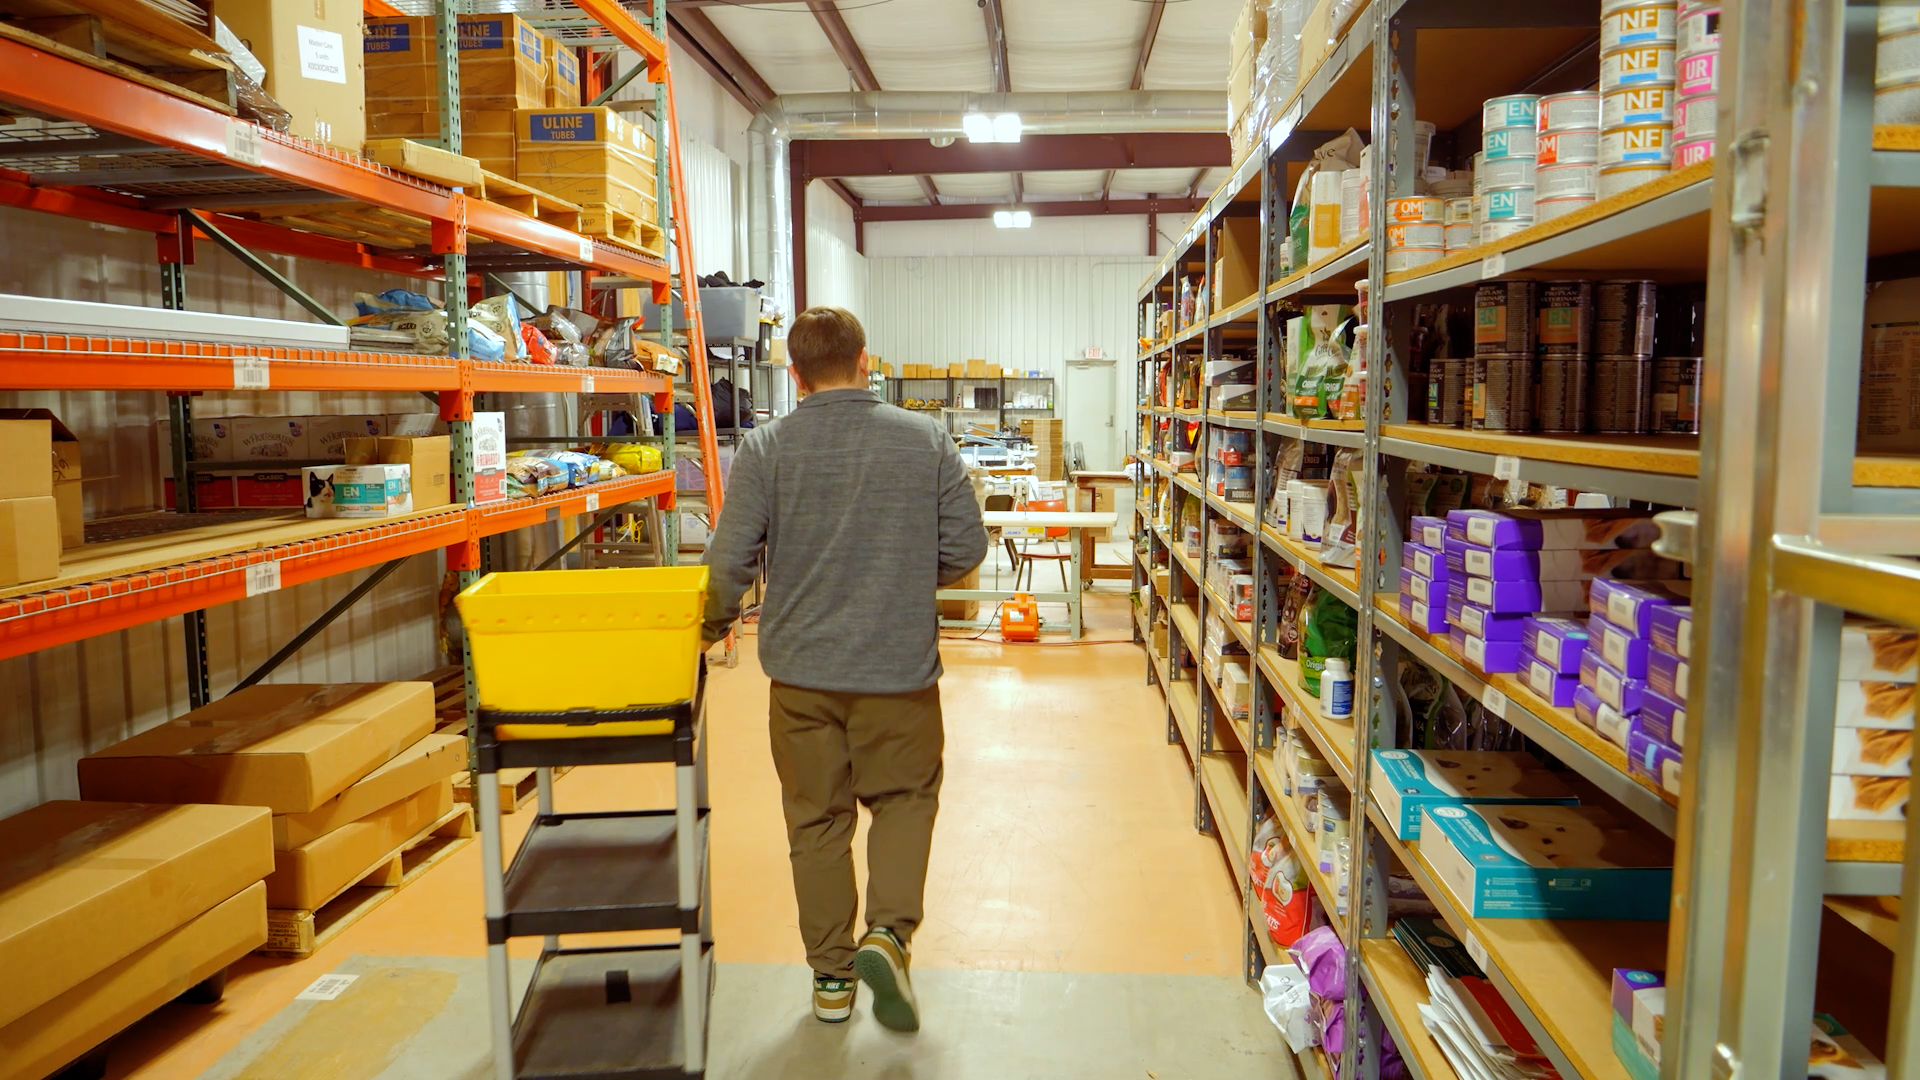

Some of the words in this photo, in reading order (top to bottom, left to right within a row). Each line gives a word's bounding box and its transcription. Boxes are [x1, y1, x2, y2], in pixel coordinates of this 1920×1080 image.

[1621, 8, 1658, 32] NF
[364, 26, 398, 39] LINE
[457, 24, 491, 37] LINE
[308, 38, 323, 48] Master
[323, 40, 334, 50] Case
[365, 42, 391, 50] TUBES
[458, 39, 484, 48] TUBES
[319, 52, 330, 61] units
[1621, 49, 1658, 72] NF
[1685, 58, 1708, 81] UR
[1626, 89, 1663, 111] NF
[1508, 101, 1535, 117] EN
[542, 115, 583, 129] ULINE
[550, 130, 576, 140] TUBES
[1487, 131, 1508, 149] EN
[1625, 128, 1662, 149] NF
[1683, 145, 1706, 168] UR
[1490, 191, 1514, 209] EN
[1401, 201, 1423, 214] OM
[1388, 226, 1404, 239] OM
[1478, 307, 1498, 325] EN
[1548, 308, 1571, 325] EN
[1088, 347, 1101, 358] EXIT
[343, 486, 360, 497] EN
[387, 480, 397, 491] EN
[825, 982, 840, 990] NIKE
